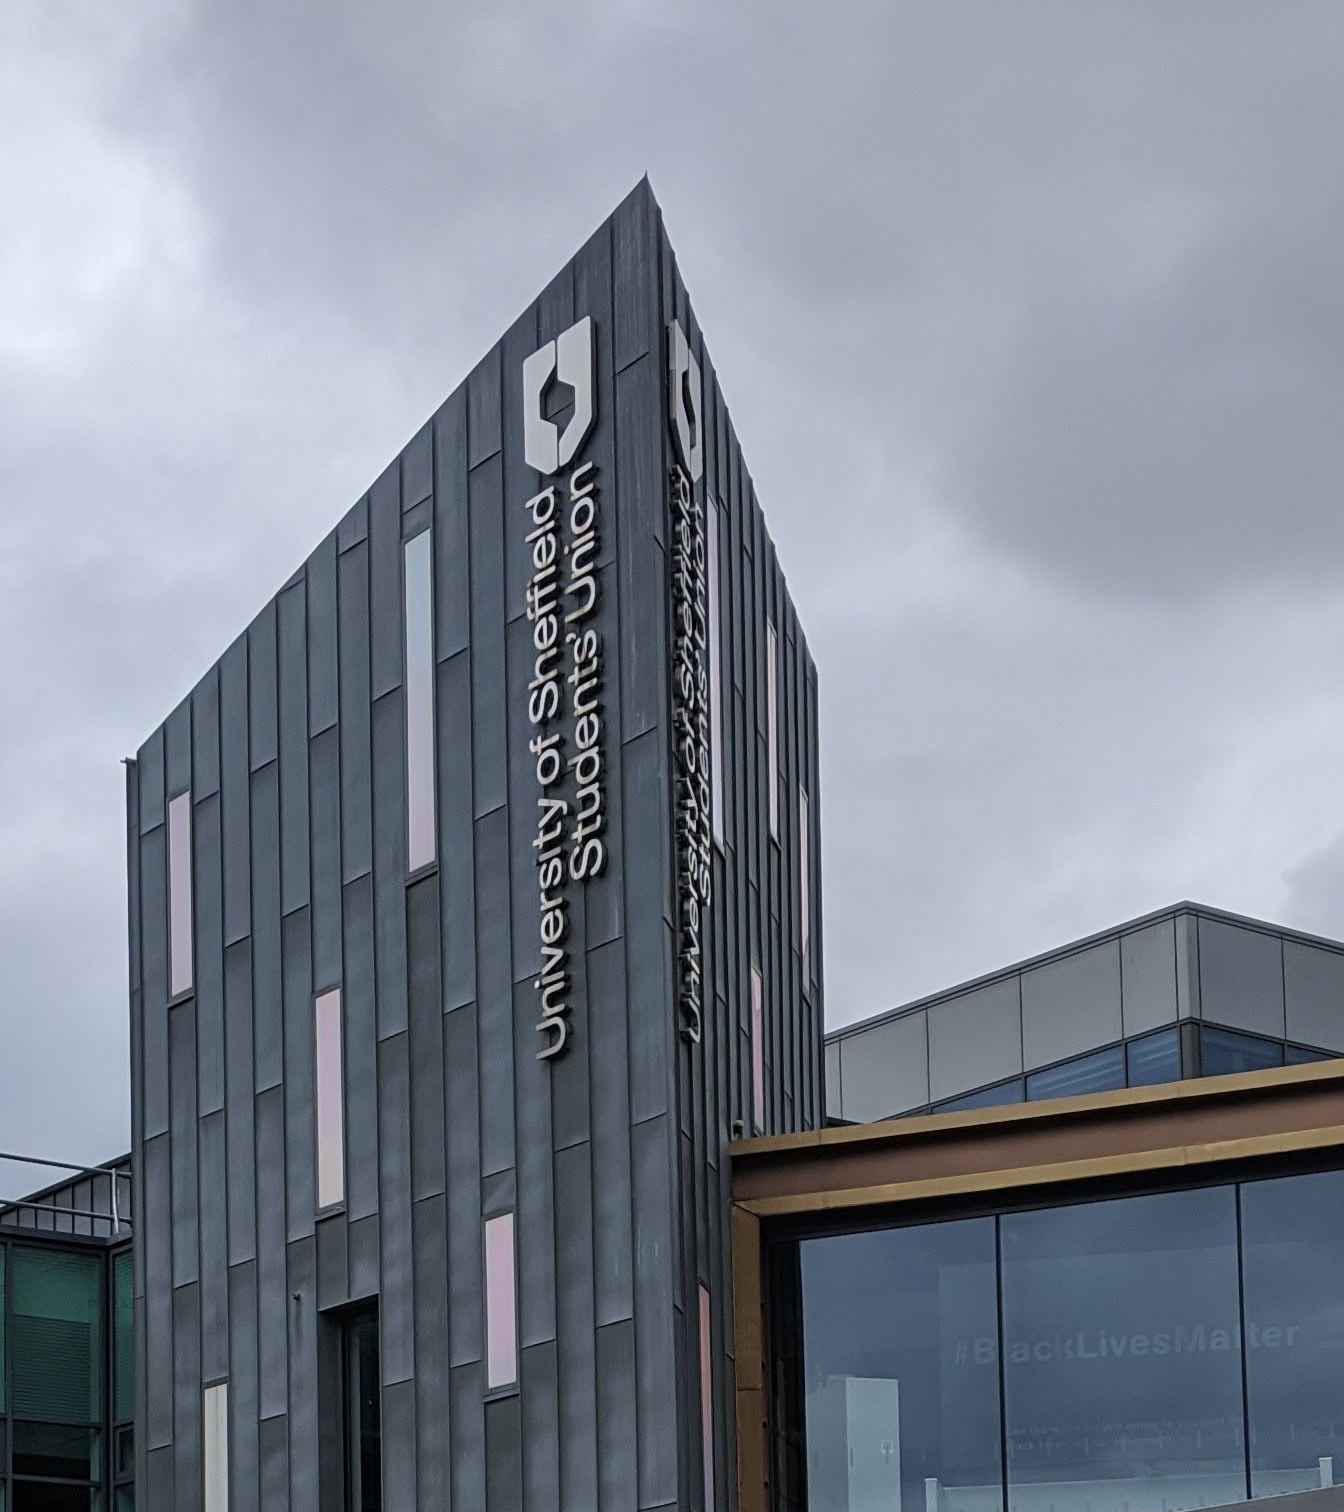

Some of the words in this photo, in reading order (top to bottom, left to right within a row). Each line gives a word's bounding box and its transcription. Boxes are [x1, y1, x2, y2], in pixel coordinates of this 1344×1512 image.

[524, 485, 559, 725] Sheffield
[562, 460, 596, 623] Union
[529, 733, 561, 787] of
[532, 797, 568, 1061] University
[954, 1321, 1301, 1367] #BackLivesMatter
